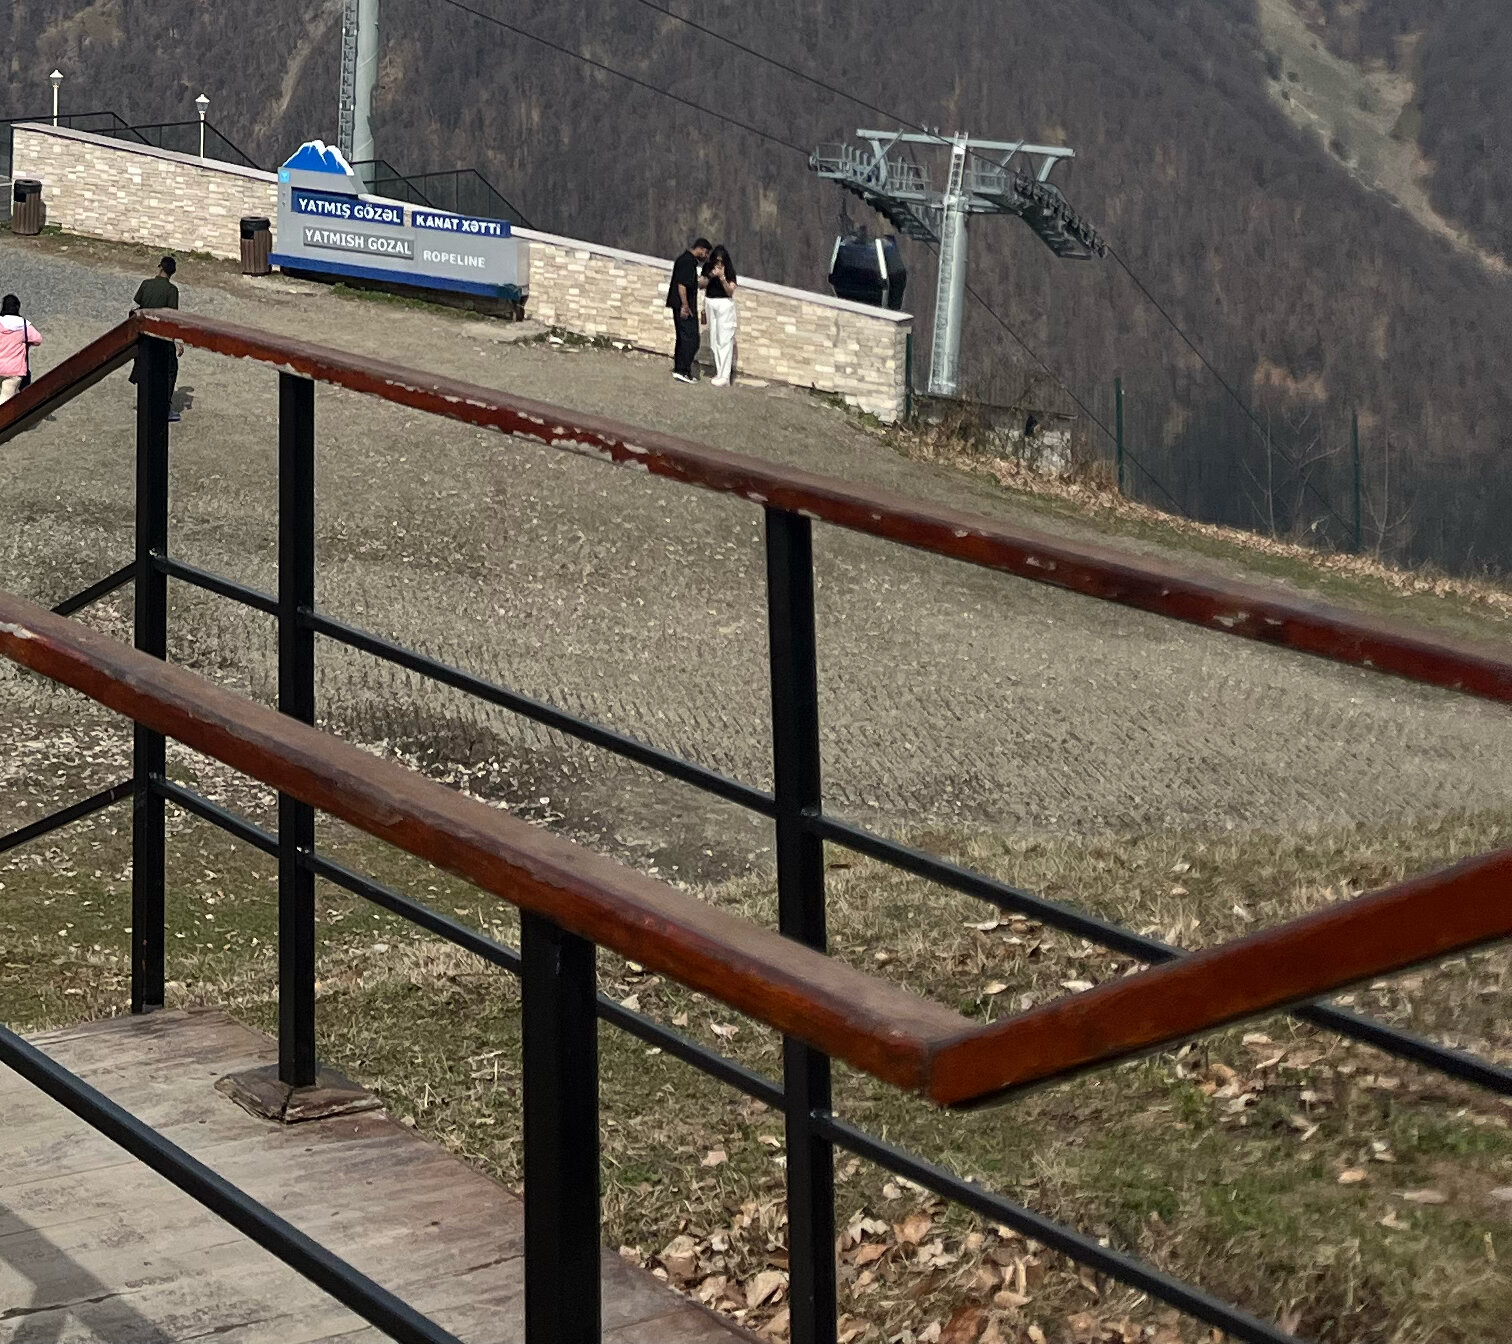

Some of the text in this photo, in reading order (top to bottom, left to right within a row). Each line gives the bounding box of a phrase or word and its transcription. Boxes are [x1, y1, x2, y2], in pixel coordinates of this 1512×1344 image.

[299, 198, 350, 218] YATMIŞ
[416, 214, 459, 231] KANAT
[305, 228, 486, 268] YATMISH GOZAL ROPELINE
